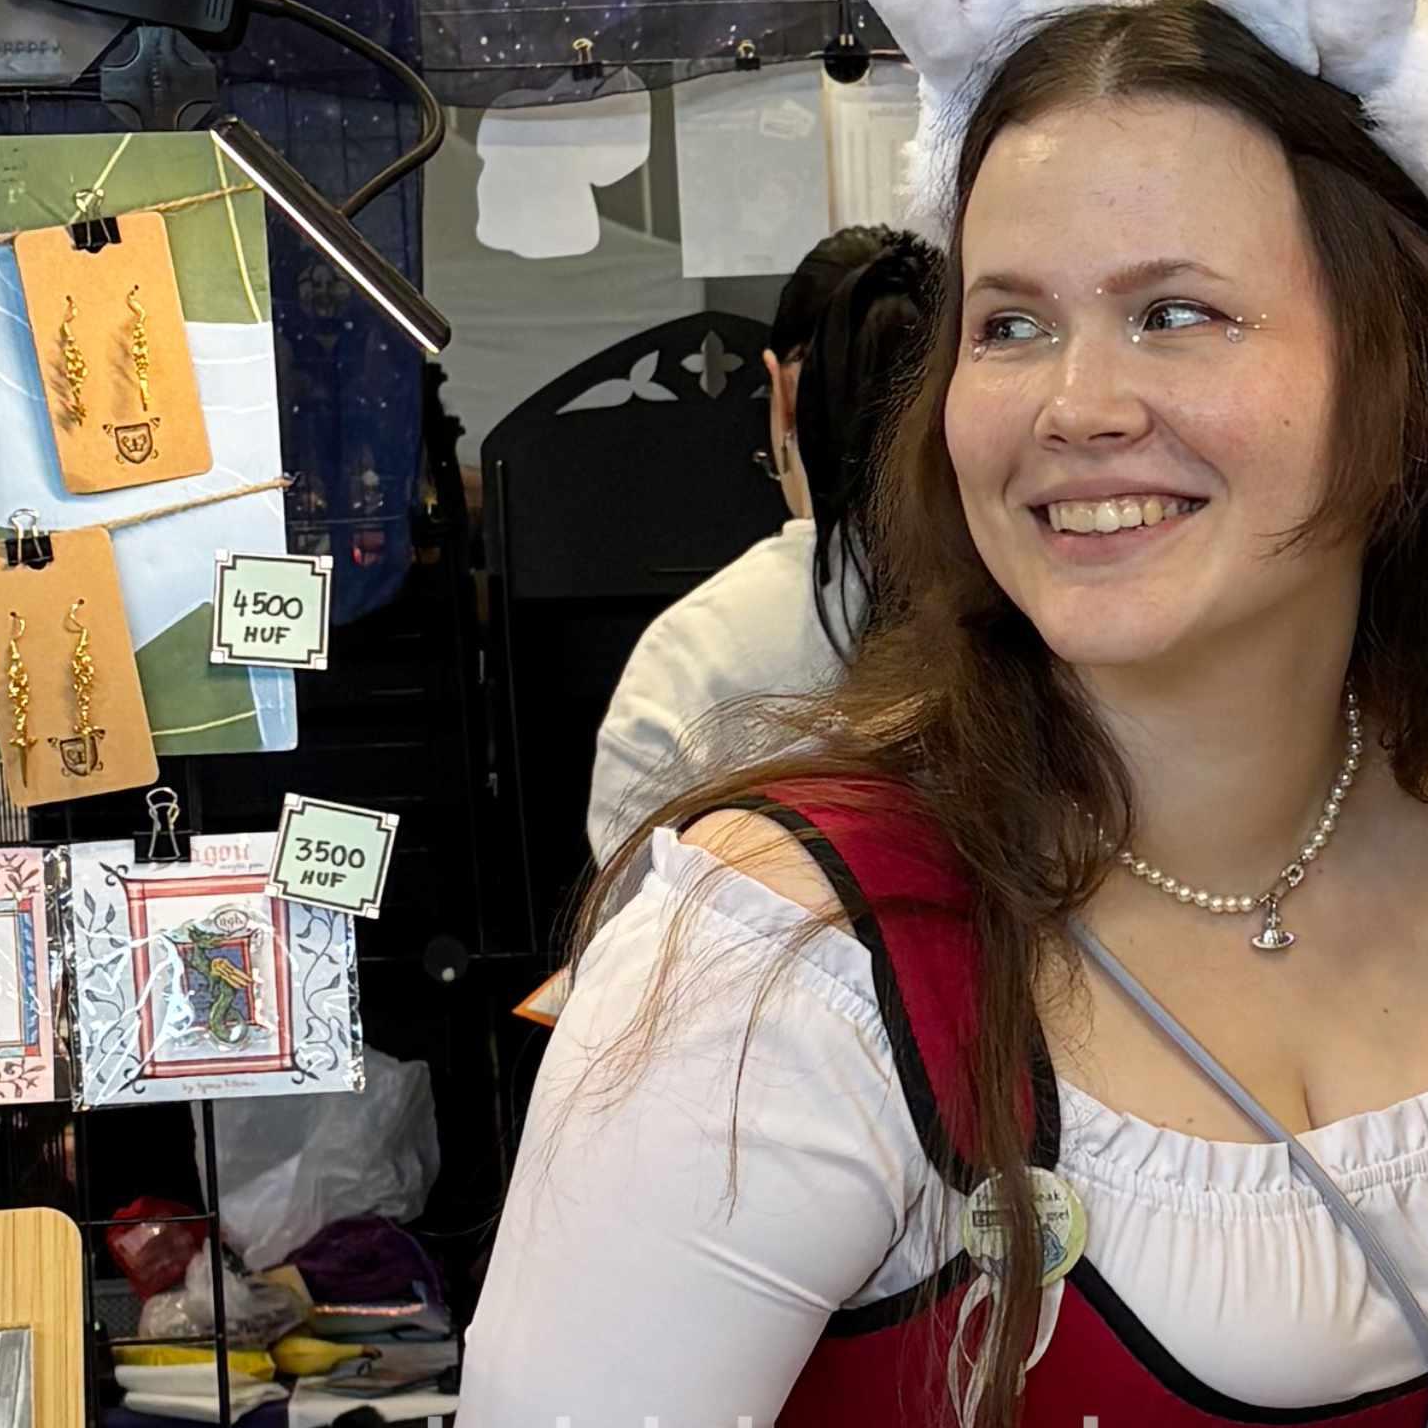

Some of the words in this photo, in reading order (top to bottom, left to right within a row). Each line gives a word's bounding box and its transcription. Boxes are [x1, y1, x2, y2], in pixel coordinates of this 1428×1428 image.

[233, 589, 304, 625] 4500
[244, 627, 290, 645] HUF
[296, 839, 367, 873] 3500
[301, 870, 347, 889] HUF
